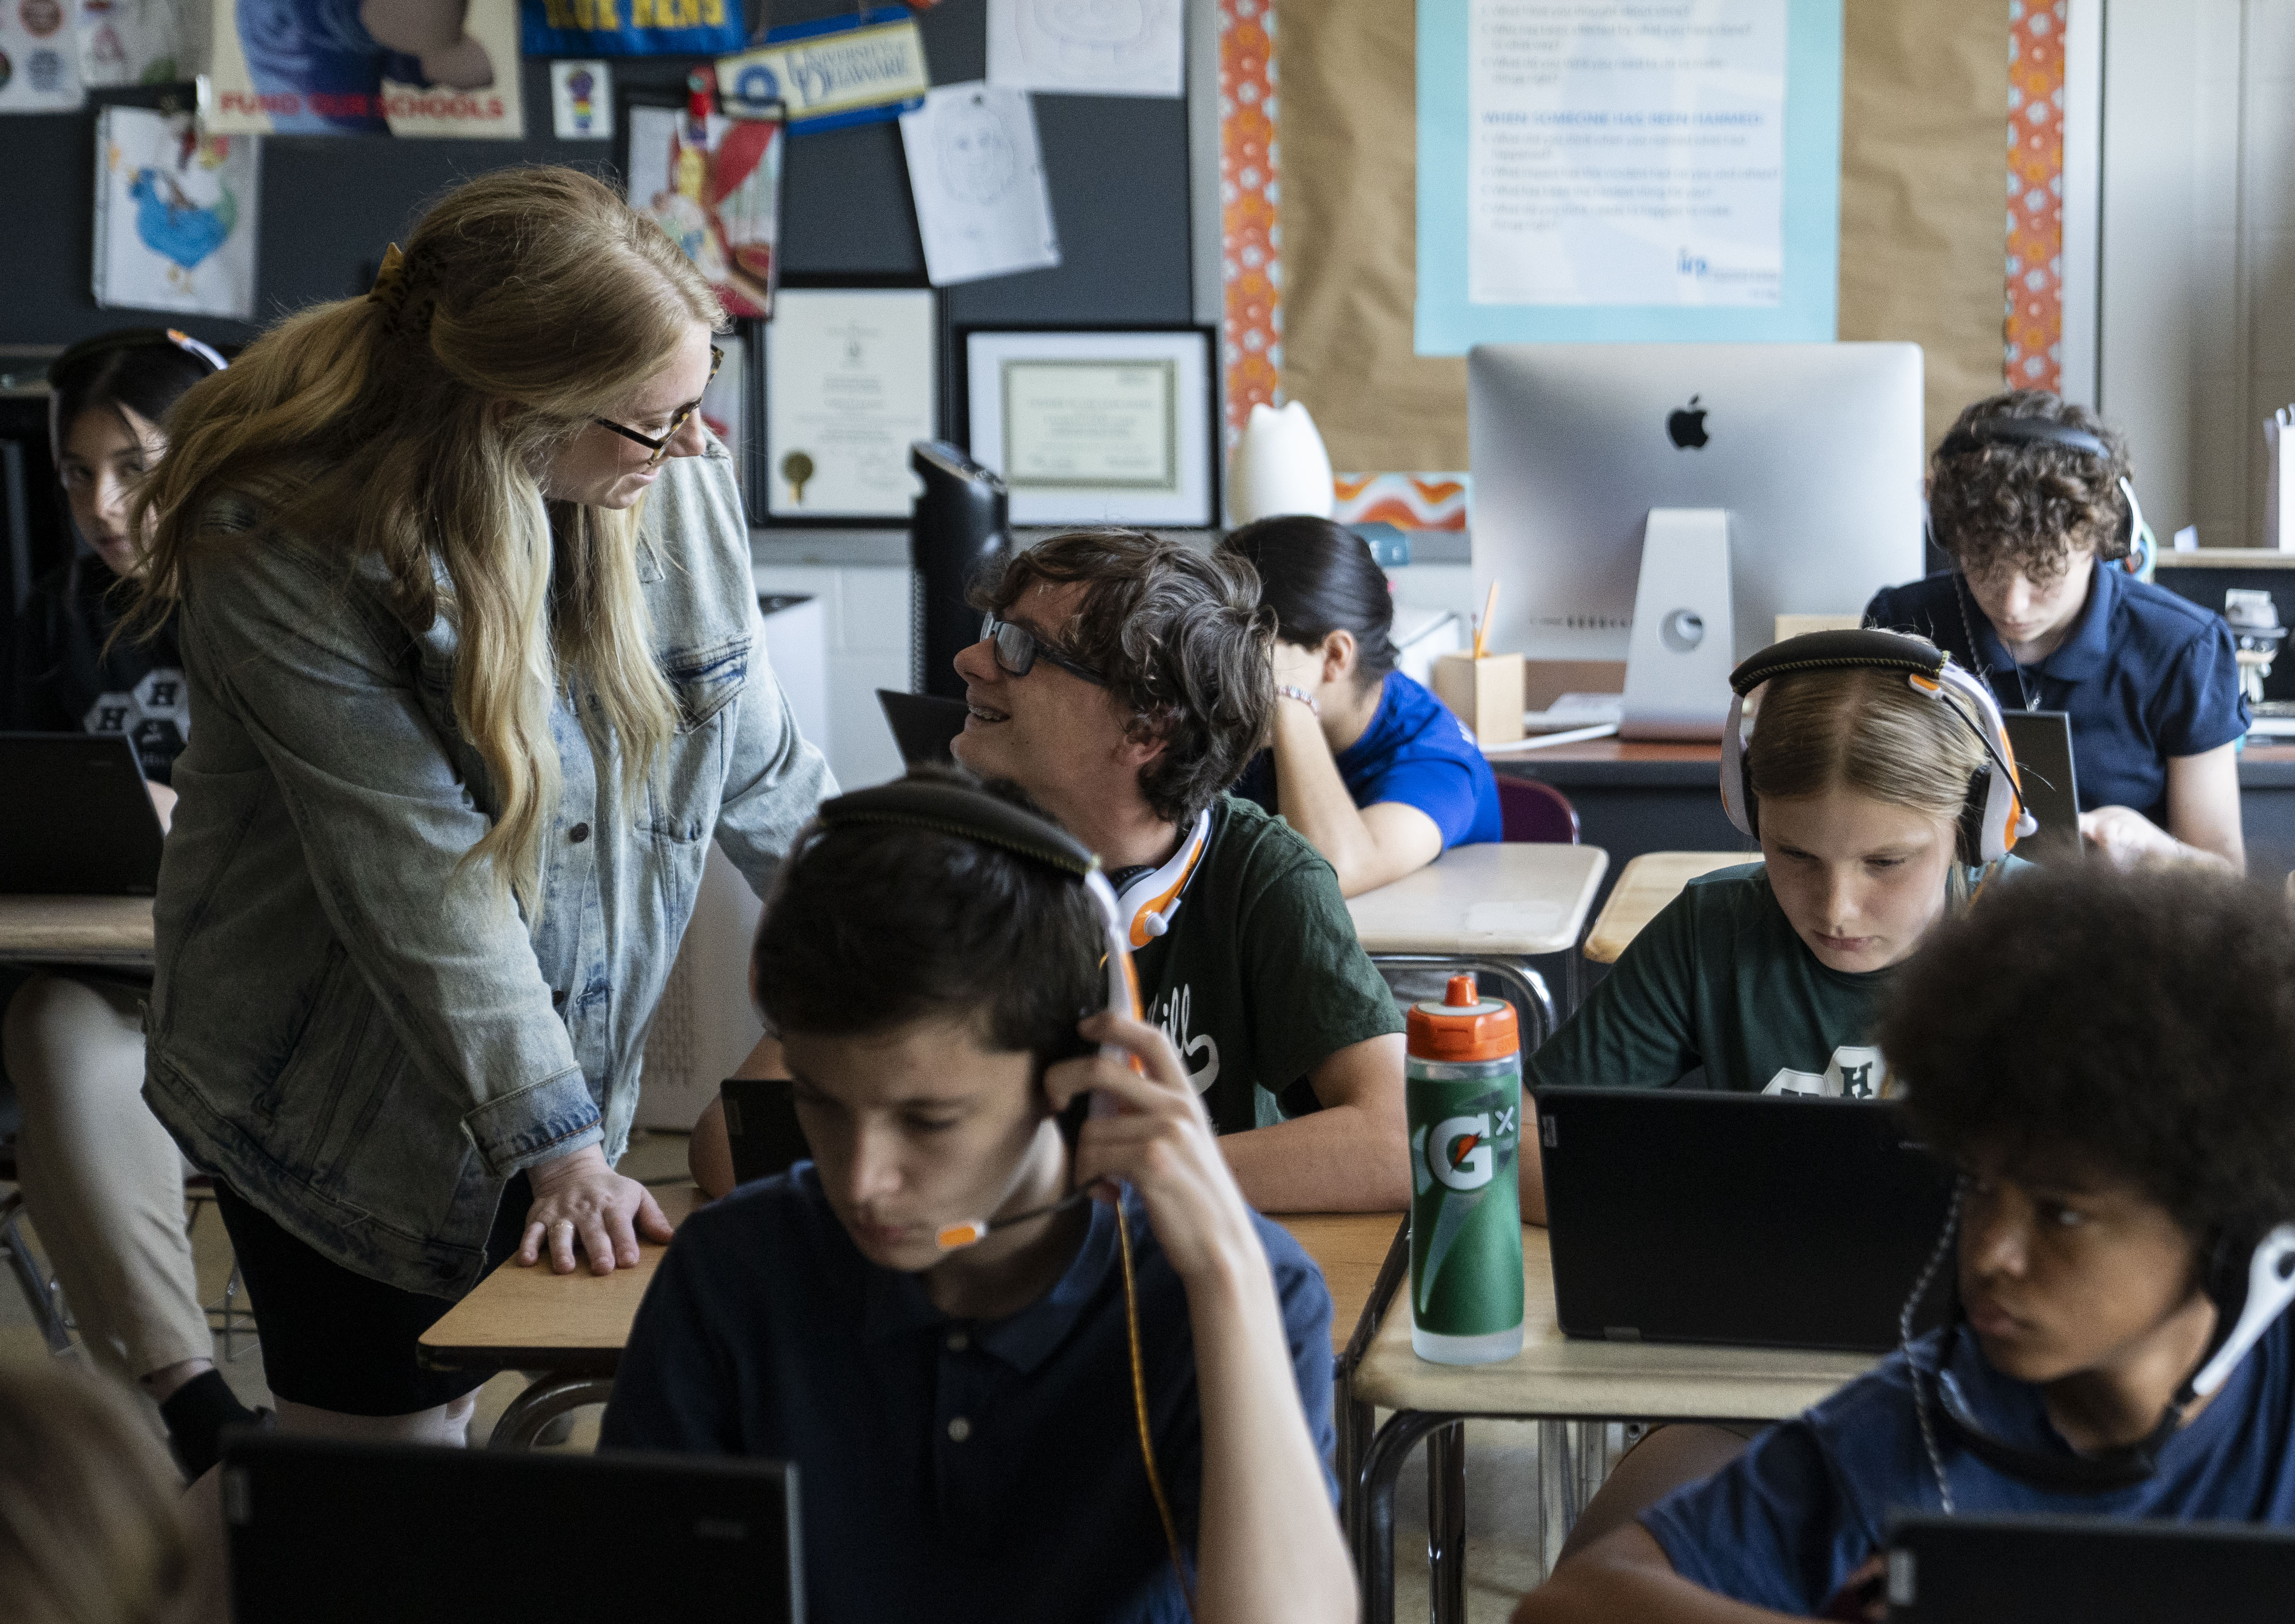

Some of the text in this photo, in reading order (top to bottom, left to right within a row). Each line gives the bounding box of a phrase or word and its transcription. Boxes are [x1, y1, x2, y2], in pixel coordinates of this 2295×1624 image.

[220, 91, 504, 120] FUND OUR SCHOOLS
